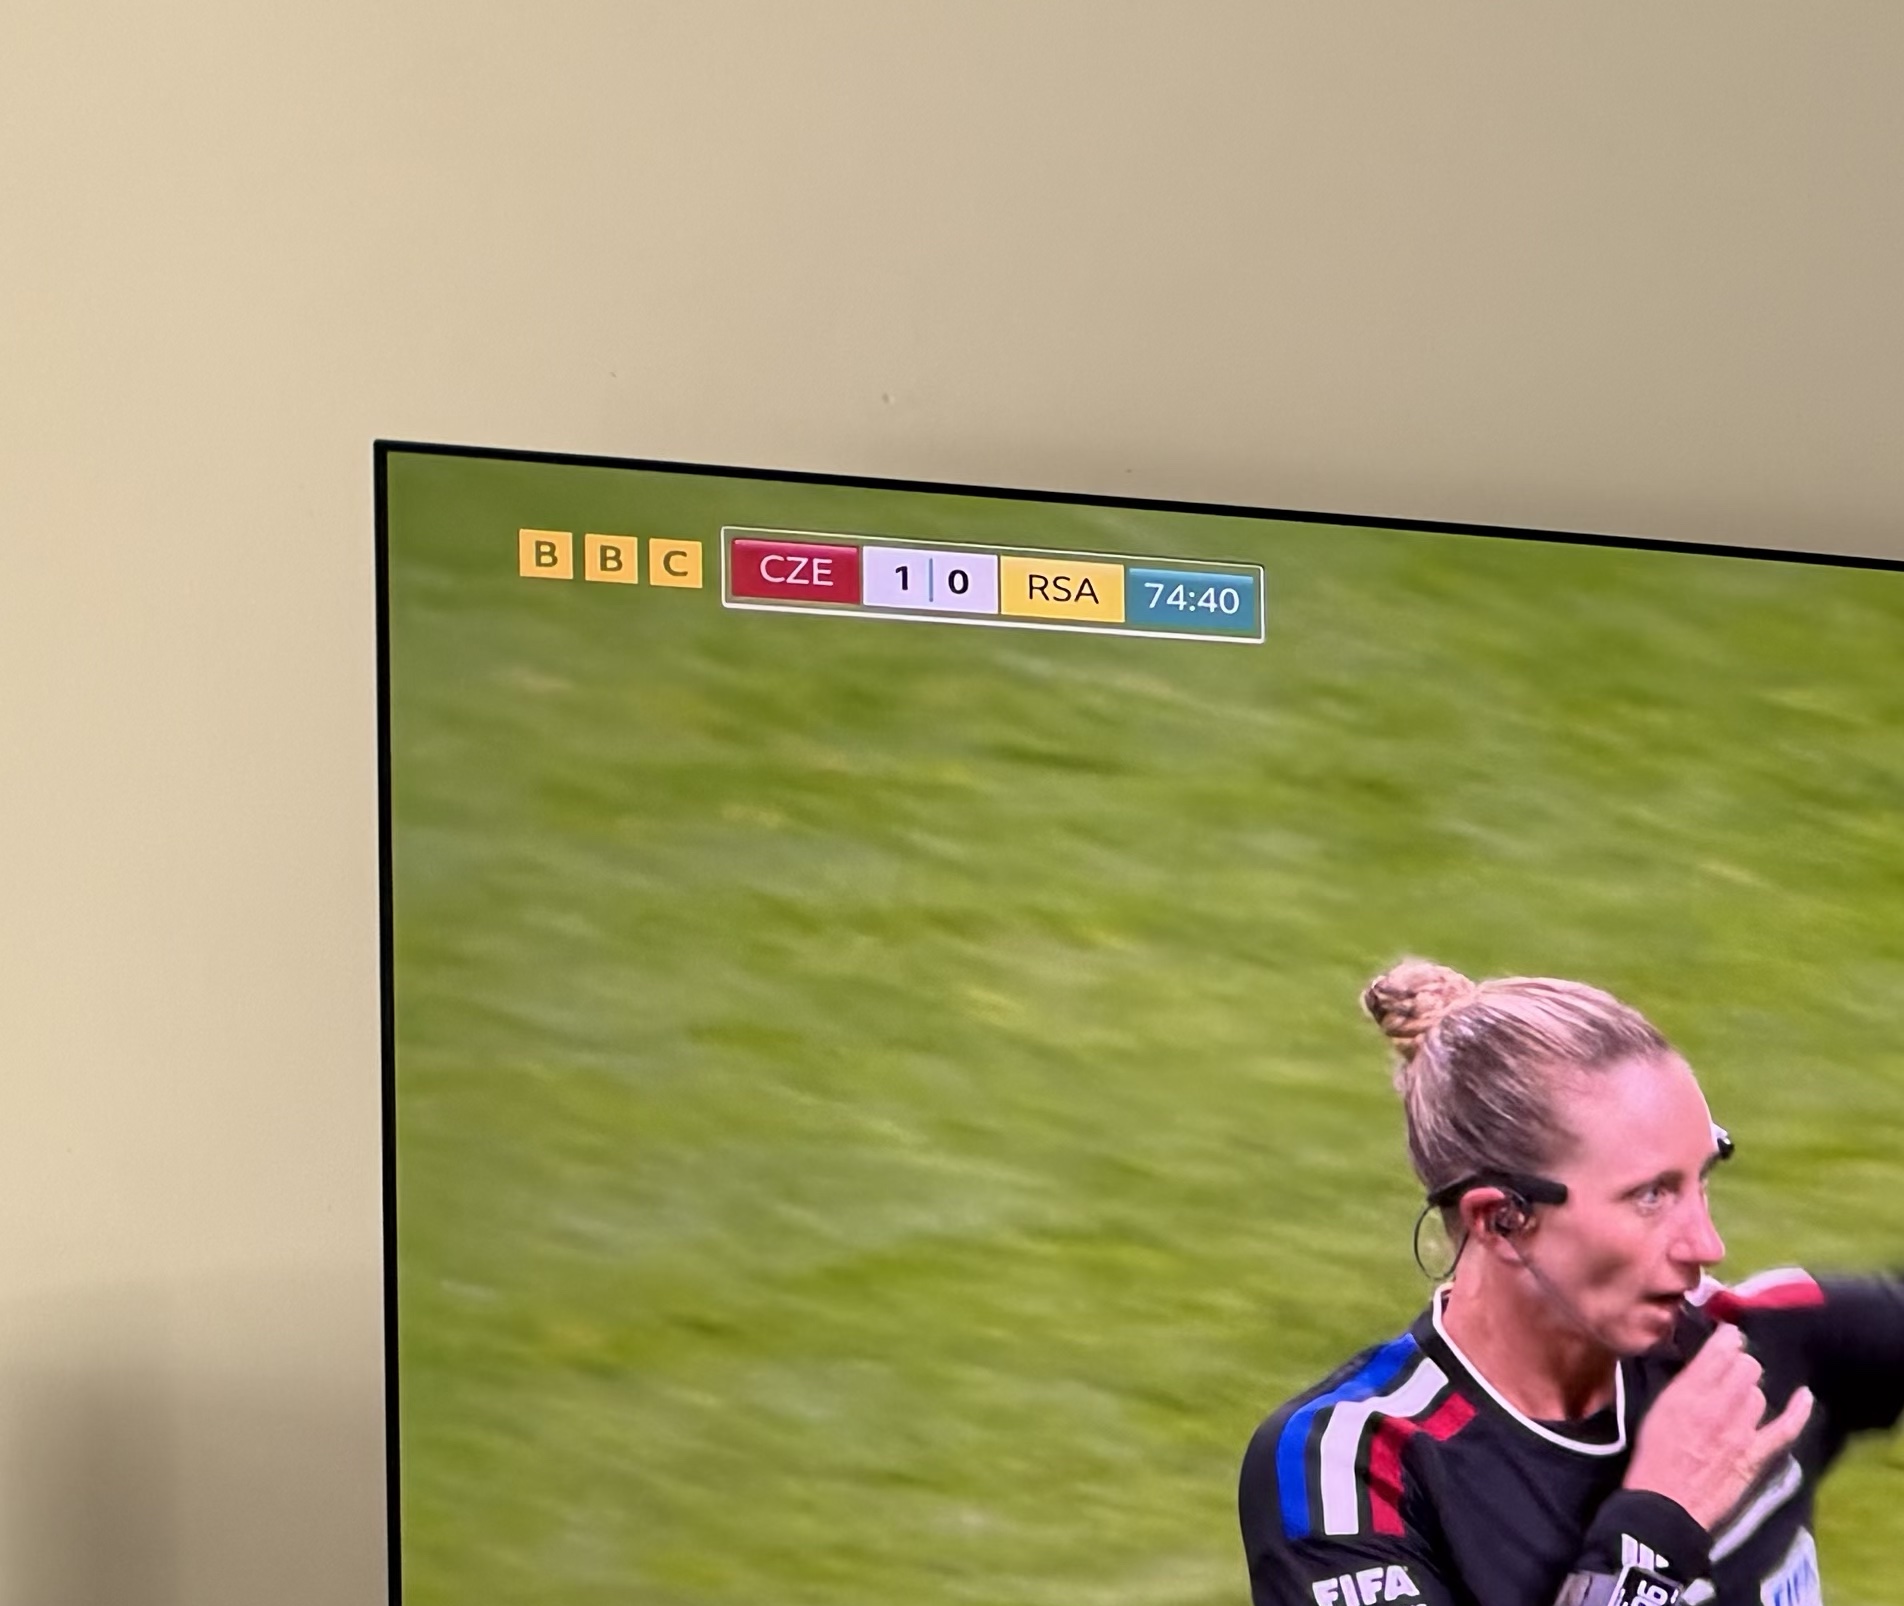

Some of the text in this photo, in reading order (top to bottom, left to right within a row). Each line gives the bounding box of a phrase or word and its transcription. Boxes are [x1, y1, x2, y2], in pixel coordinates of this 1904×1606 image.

[759, 553, 1240, 615] CZE 1 0 RSA 74:40
